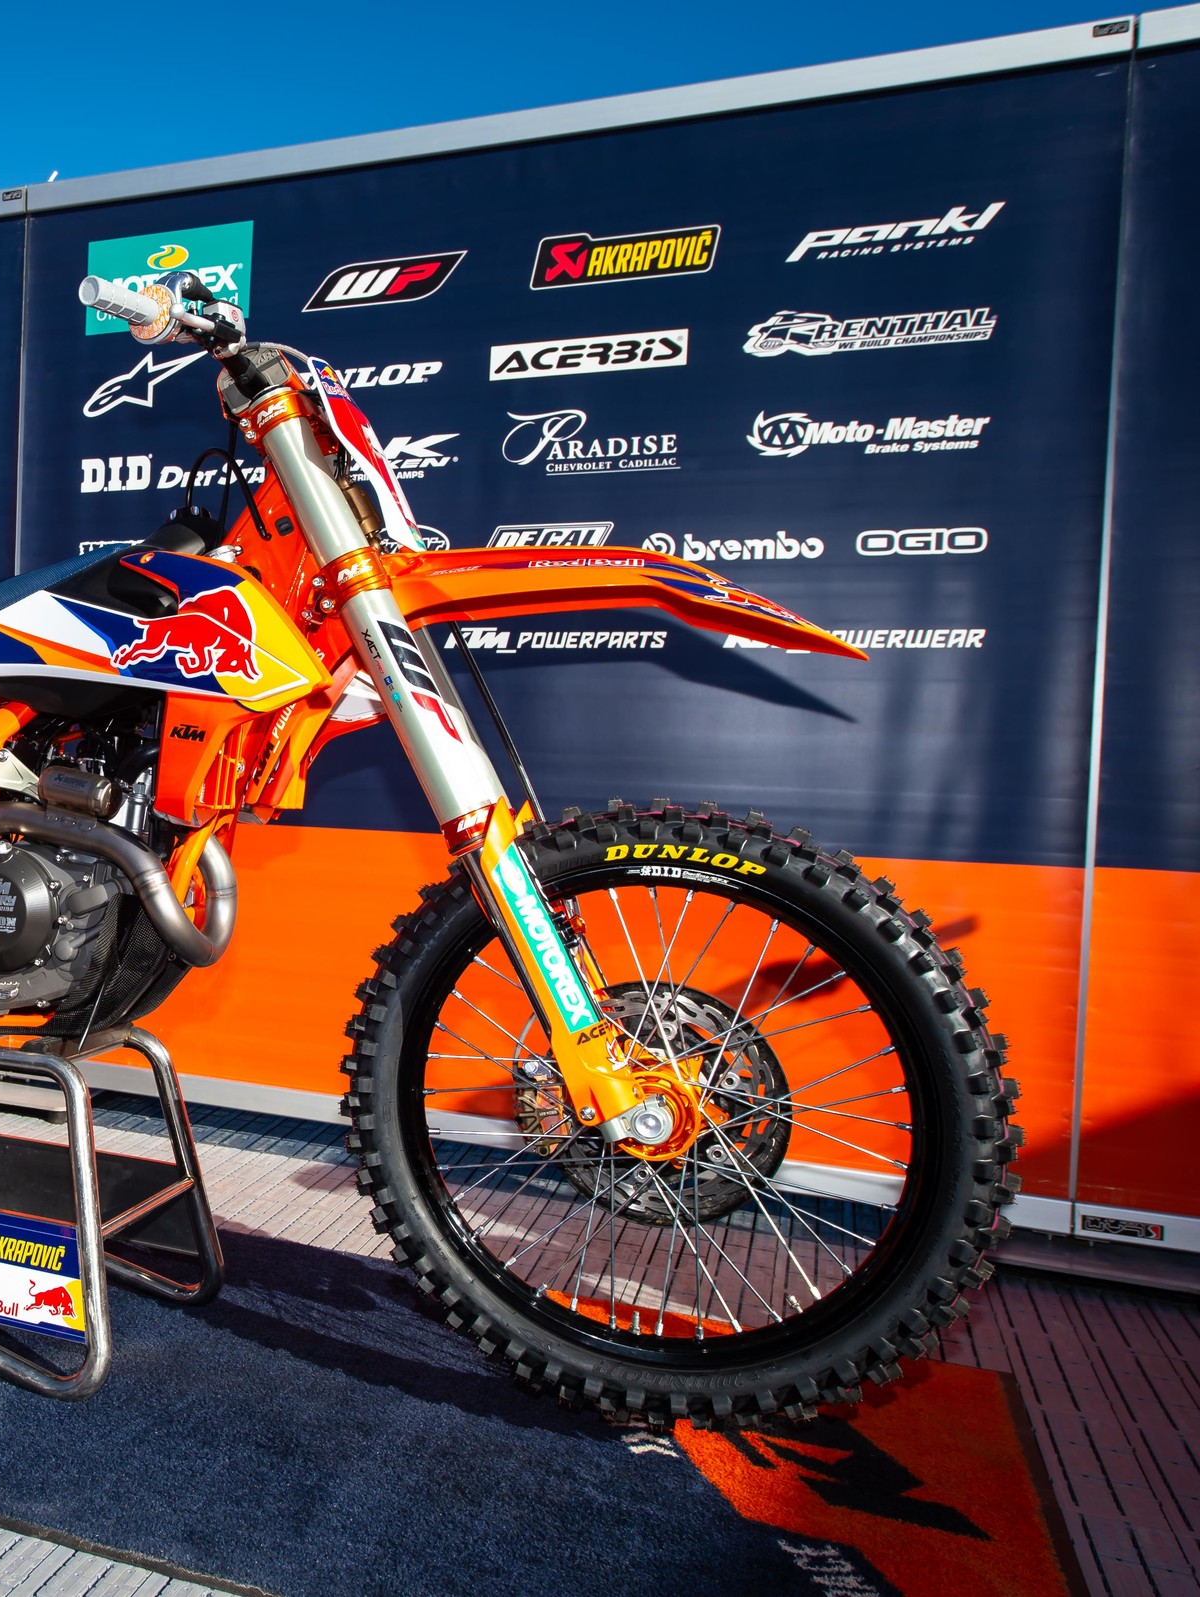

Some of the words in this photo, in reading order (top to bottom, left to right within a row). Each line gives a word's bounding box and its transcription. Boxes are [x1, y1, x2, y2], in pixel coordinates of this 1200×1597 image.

[785, 202, 1006, 263] pankl
[816, 245, 883, 260] RACING
[890, 236, 975, 253] SYSTEMS
[325, 261, 442, 303] WP
[812, 307, 997, 341] RENTHAL
[837, 341, 856, 350] WE
[859, 338, 891, 349] BUILD
[894, 330, 990, 346] CHAMPIONSHIPS
[502, 409, 678, 466] PARADISE
[802, 414, 990, 445] Moto-Master
[864, 442, 910, 454] Brake
[912, 439, 979, 452] Systems
[683, 530, 824, 561] brembo
[858, 529, 987, 555] OGIO
[360, 628, 382, 660] XACT
[170, 723, 206, 743] KTM
[603, 843, 767, 875] DUNLOP
[515, 895, 595, 1027] MOTOREX
